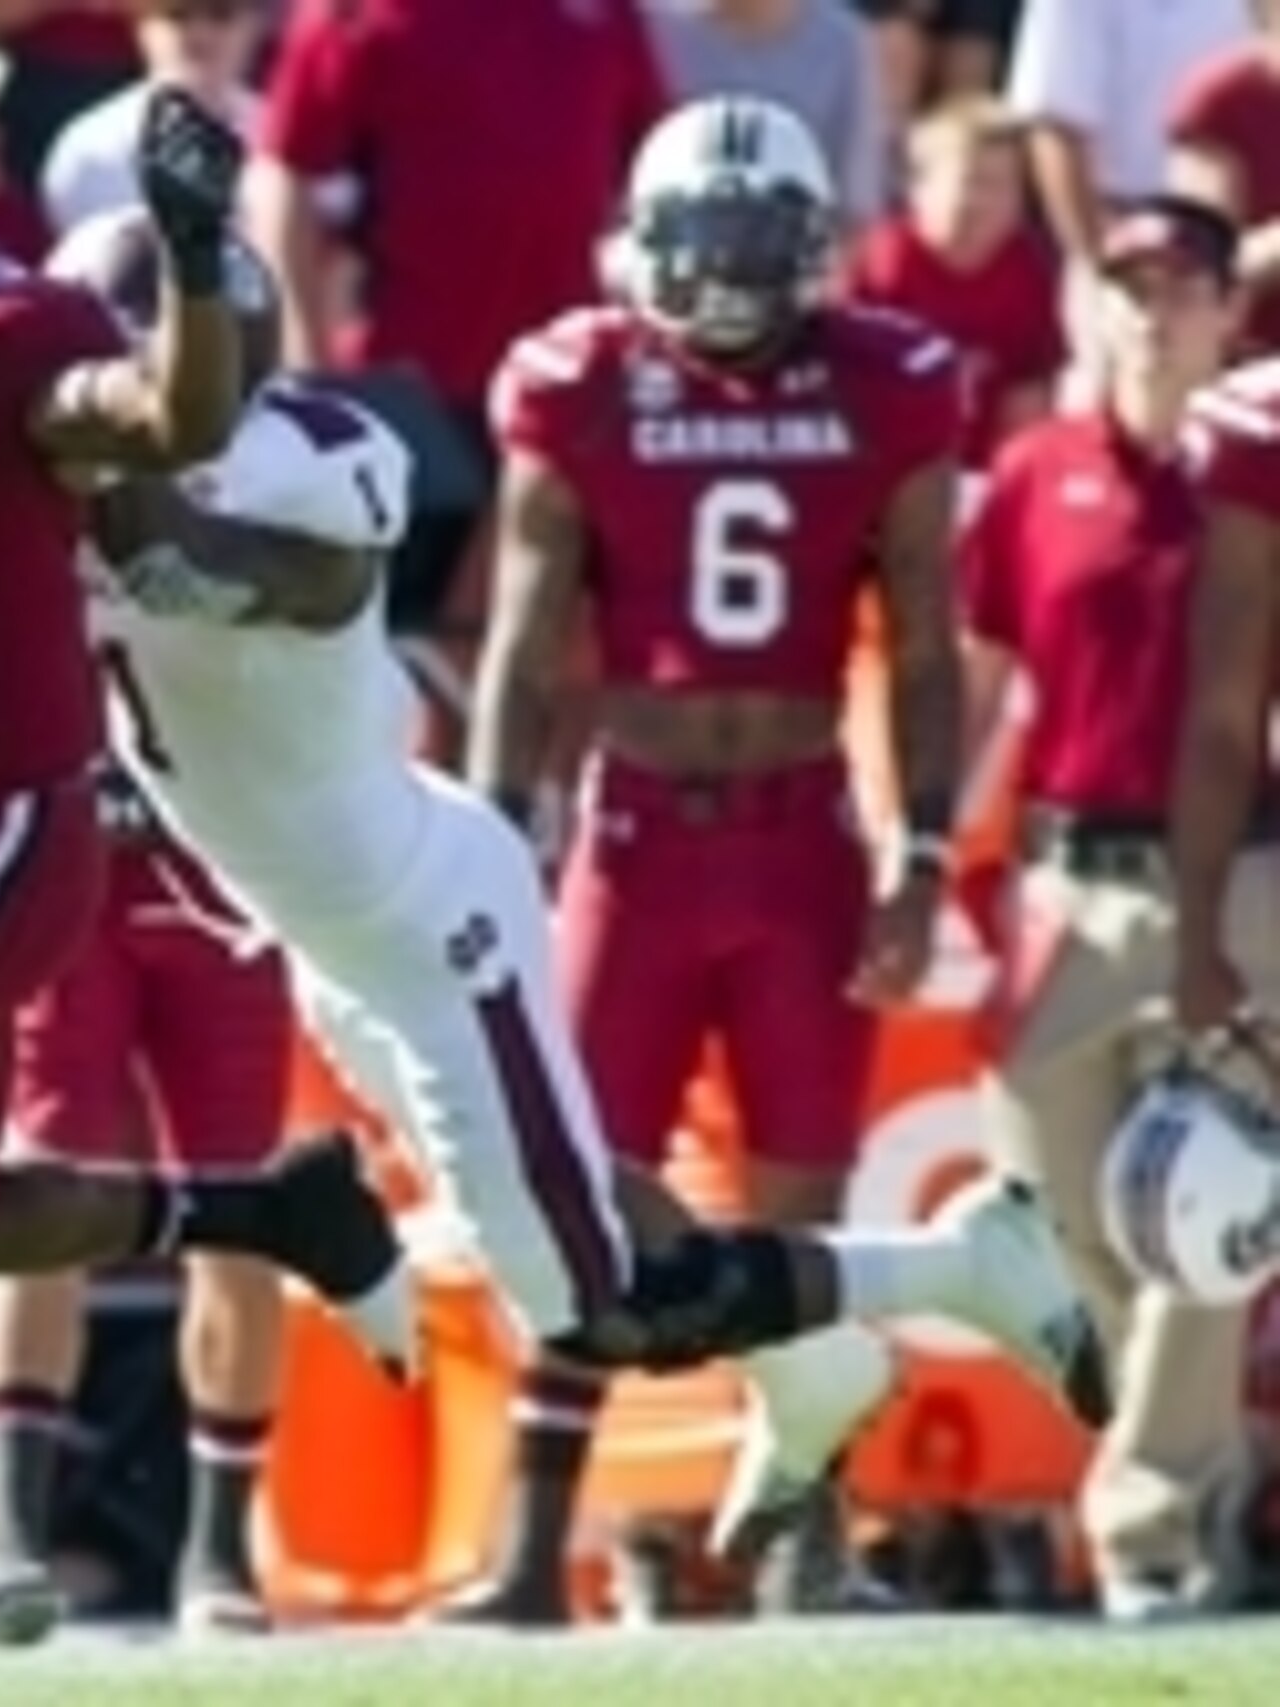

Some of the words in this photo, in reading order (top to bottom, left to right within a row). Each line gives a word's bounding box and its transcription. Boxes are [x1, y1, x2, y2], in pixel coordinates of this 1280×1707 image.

[632, 414, 854, 462] CAROLINA
[353, 464, 389, 532] 1
[693, 479, 797, 643] 6
